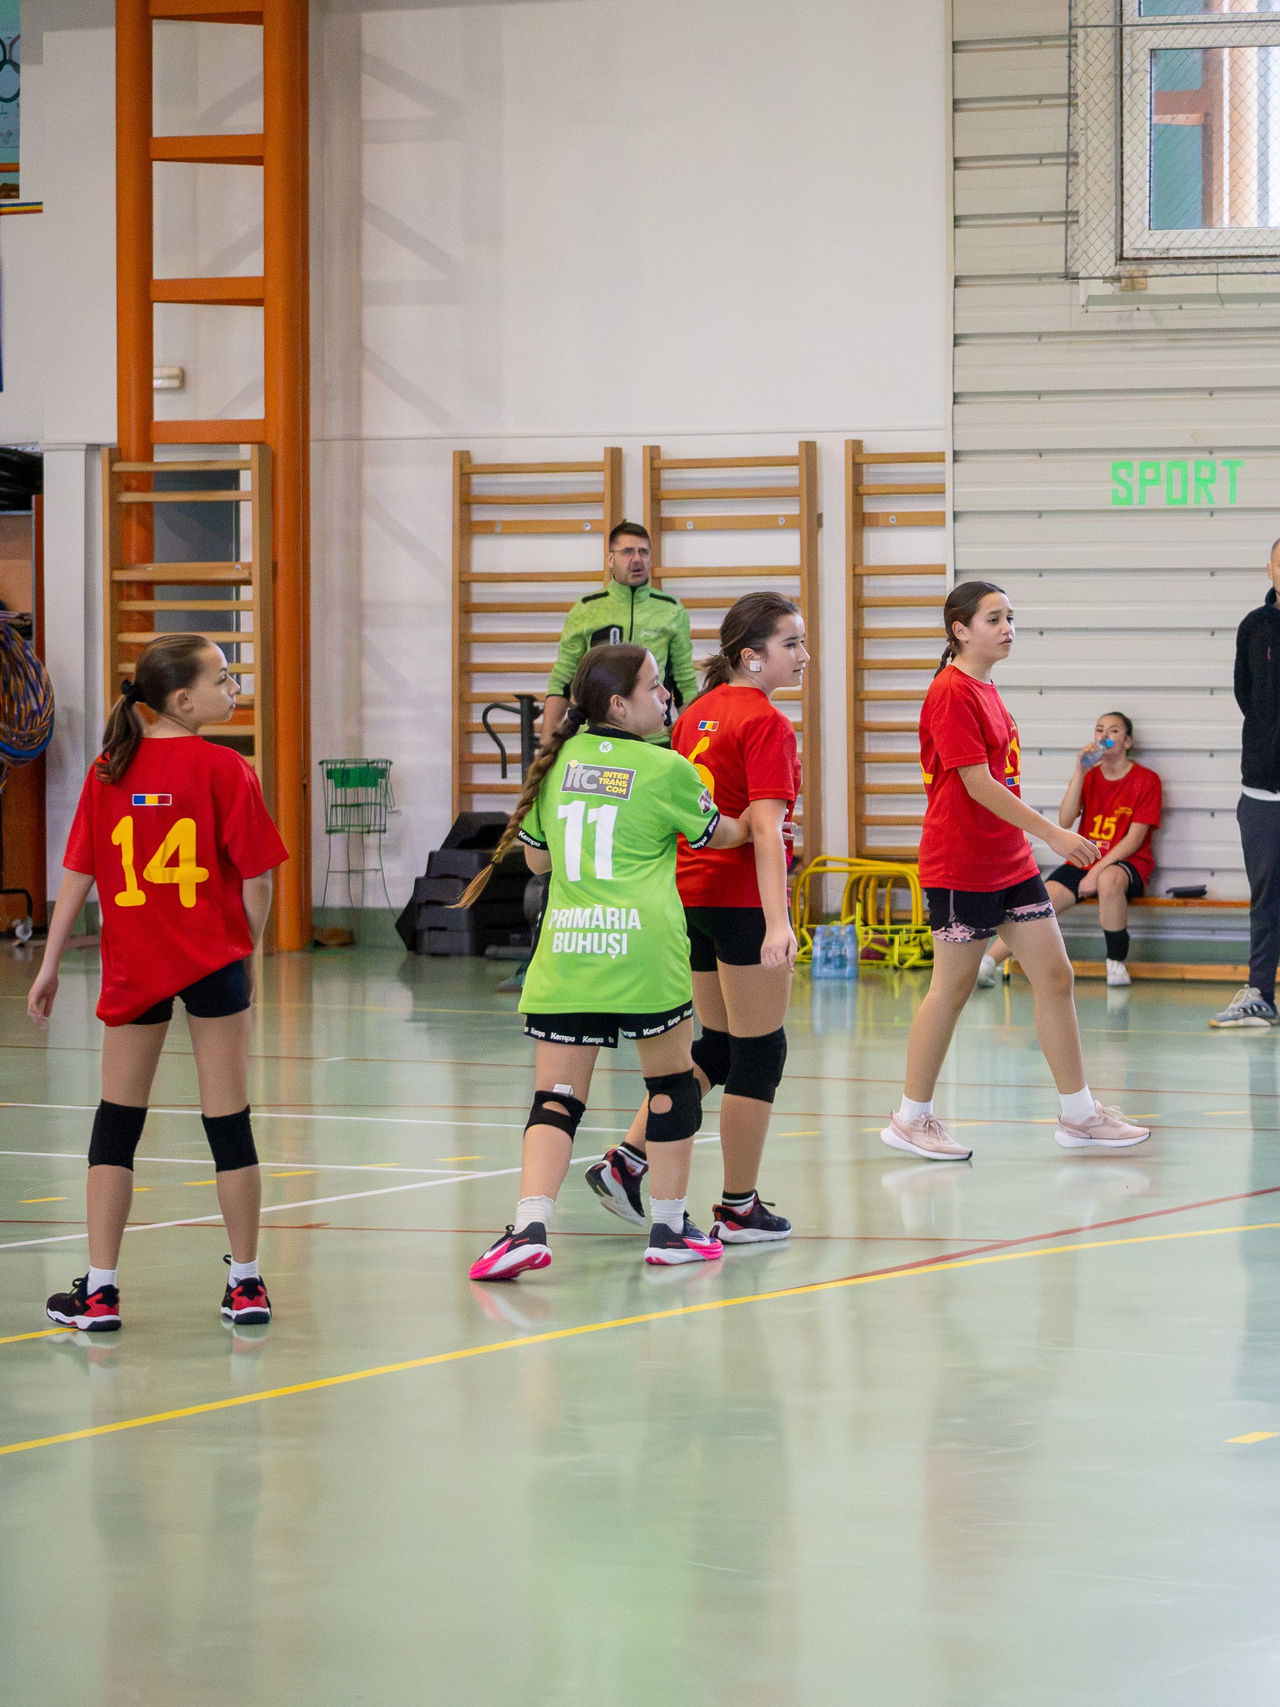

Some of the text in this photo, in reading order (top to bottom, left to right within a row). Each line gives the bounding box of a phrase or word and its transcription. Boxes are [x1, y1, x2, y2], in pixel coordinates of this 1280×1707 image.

[1111, 458, 1245, 506] SPORT
[598, 777, 628, 788] TRANS
[602, 771, 630, 781] INTER
[605, 785, 626, 795] COM
[1089, 813, 1117, 840] 15
[518, 830, 541, 847] Kempa
[557, 800, 619, 882] 11
[111, 815, 209, 908] 14
[548, 904, 642, 930] PRIMĂRIA
[552, 932, 628, 960] BUHUȘI
[550, 1032, 576, 1043] Kempa
[582, 1036, 604, 1045] Kempa
[643, 1025, 665, 1036] Kempa
